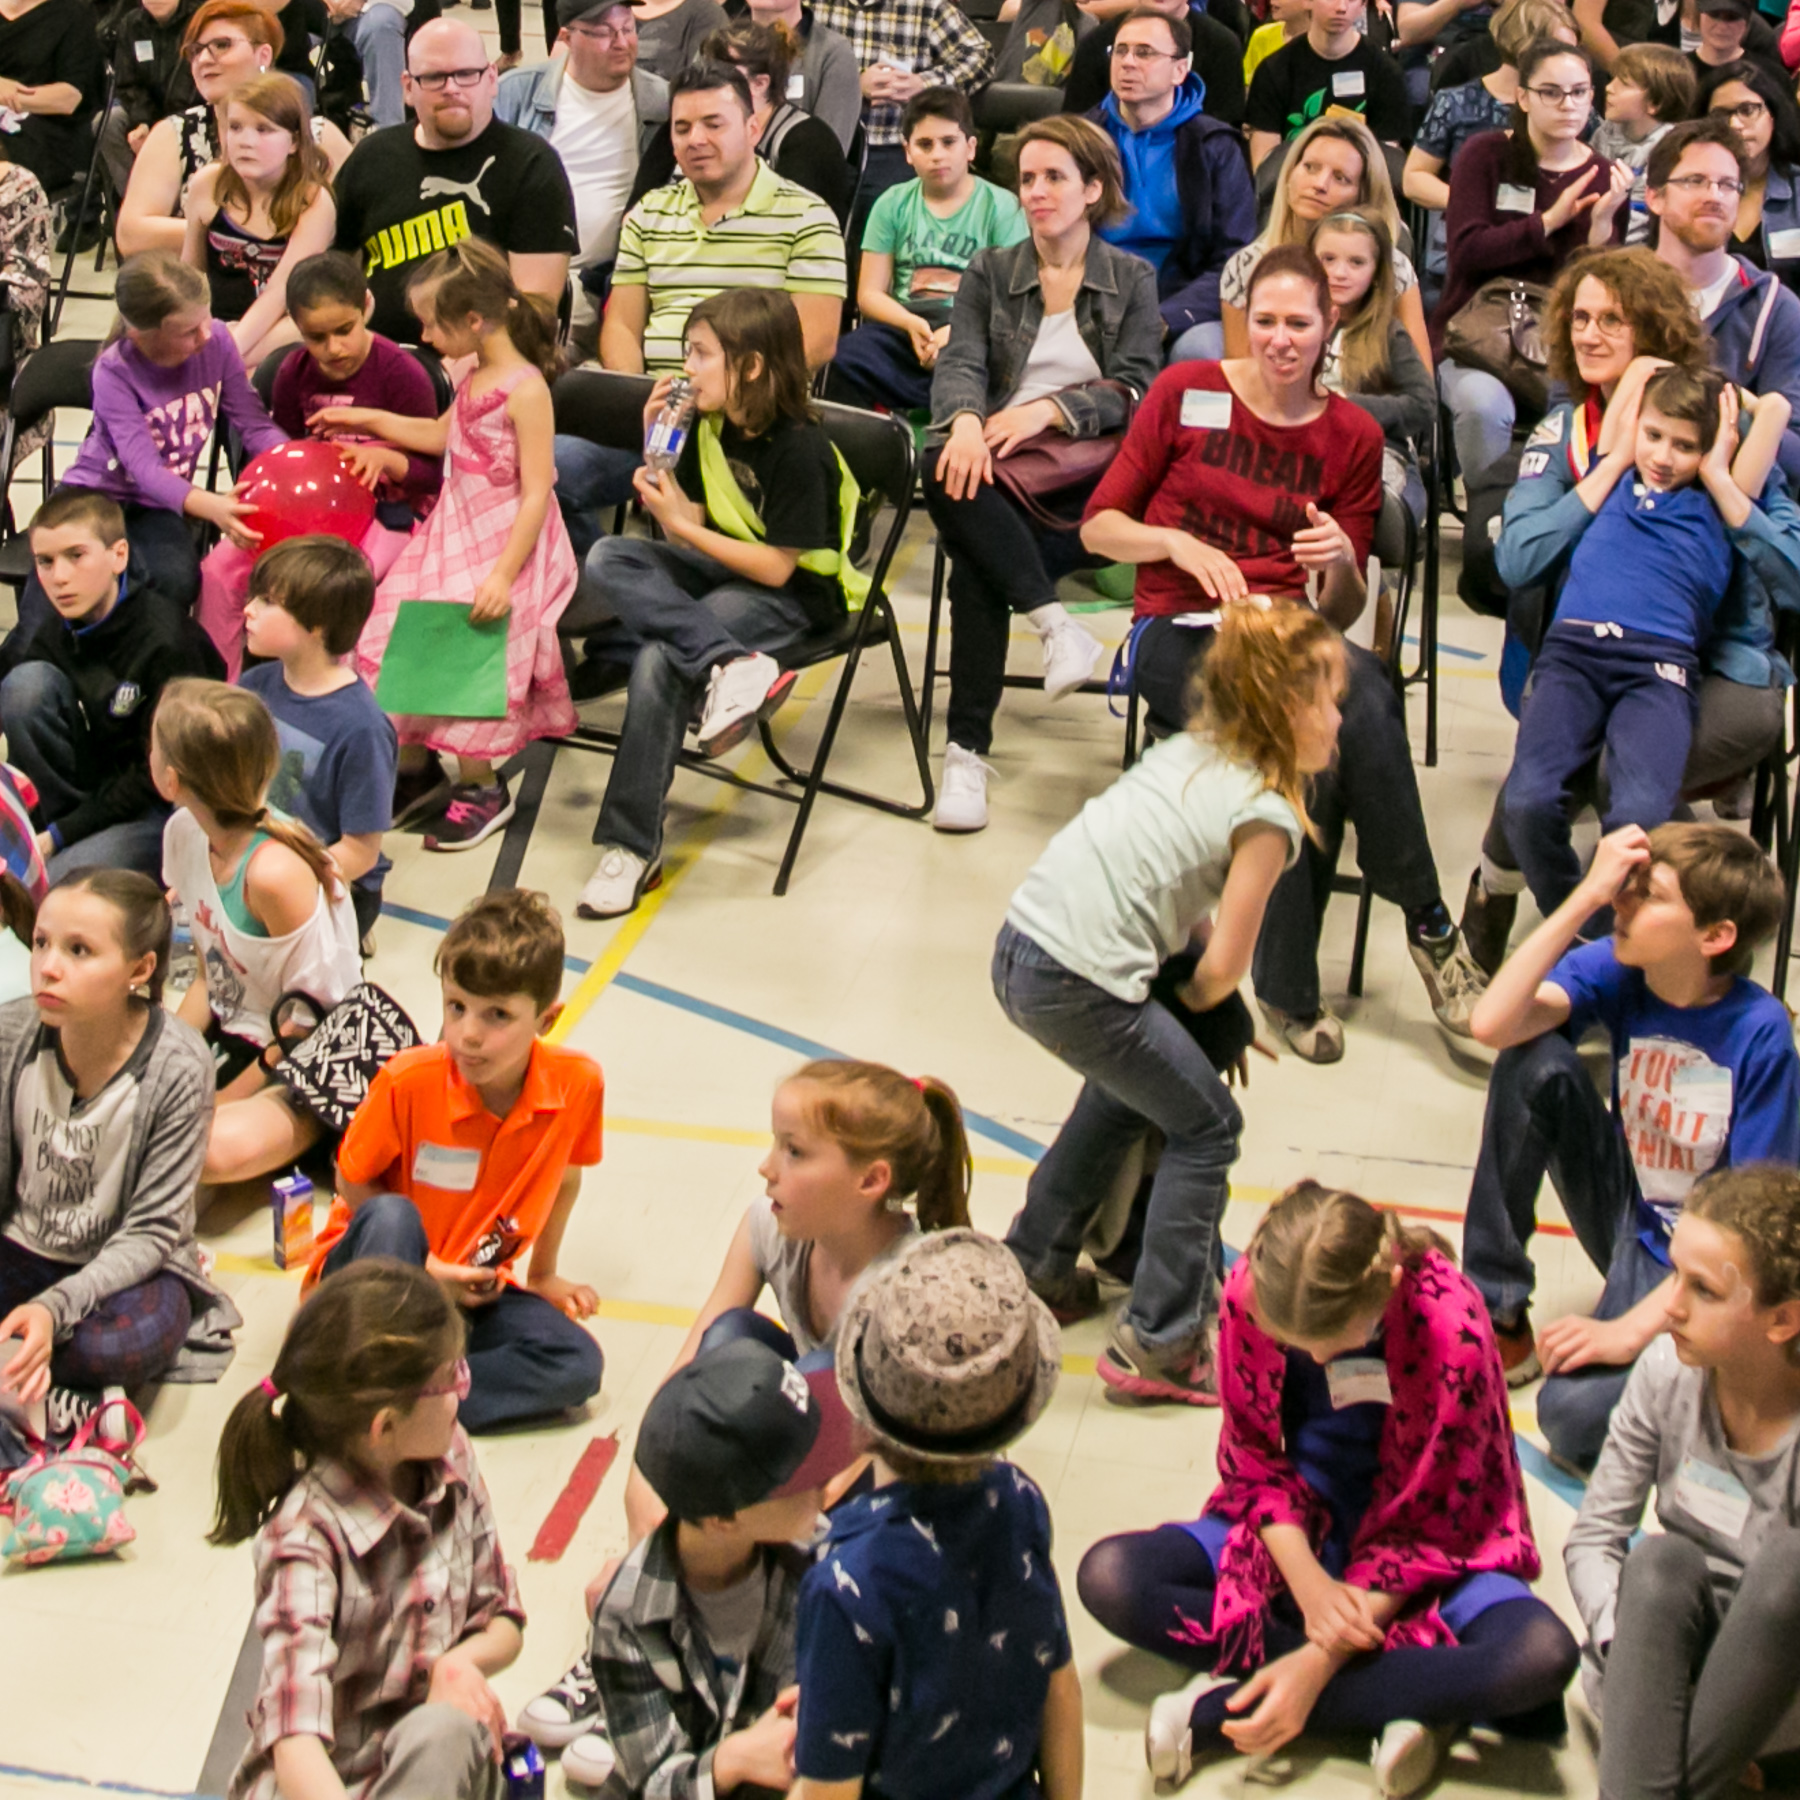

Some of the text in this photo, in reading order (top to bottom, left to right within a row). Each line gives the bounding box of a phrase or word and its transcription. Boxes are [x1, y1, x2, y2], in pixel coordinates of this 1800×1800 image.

[365, 199, 472, 278] PUMA
[65, 1123, 102, 1153] NOT
[1638, 1093, 1708, 1143] FAIT
